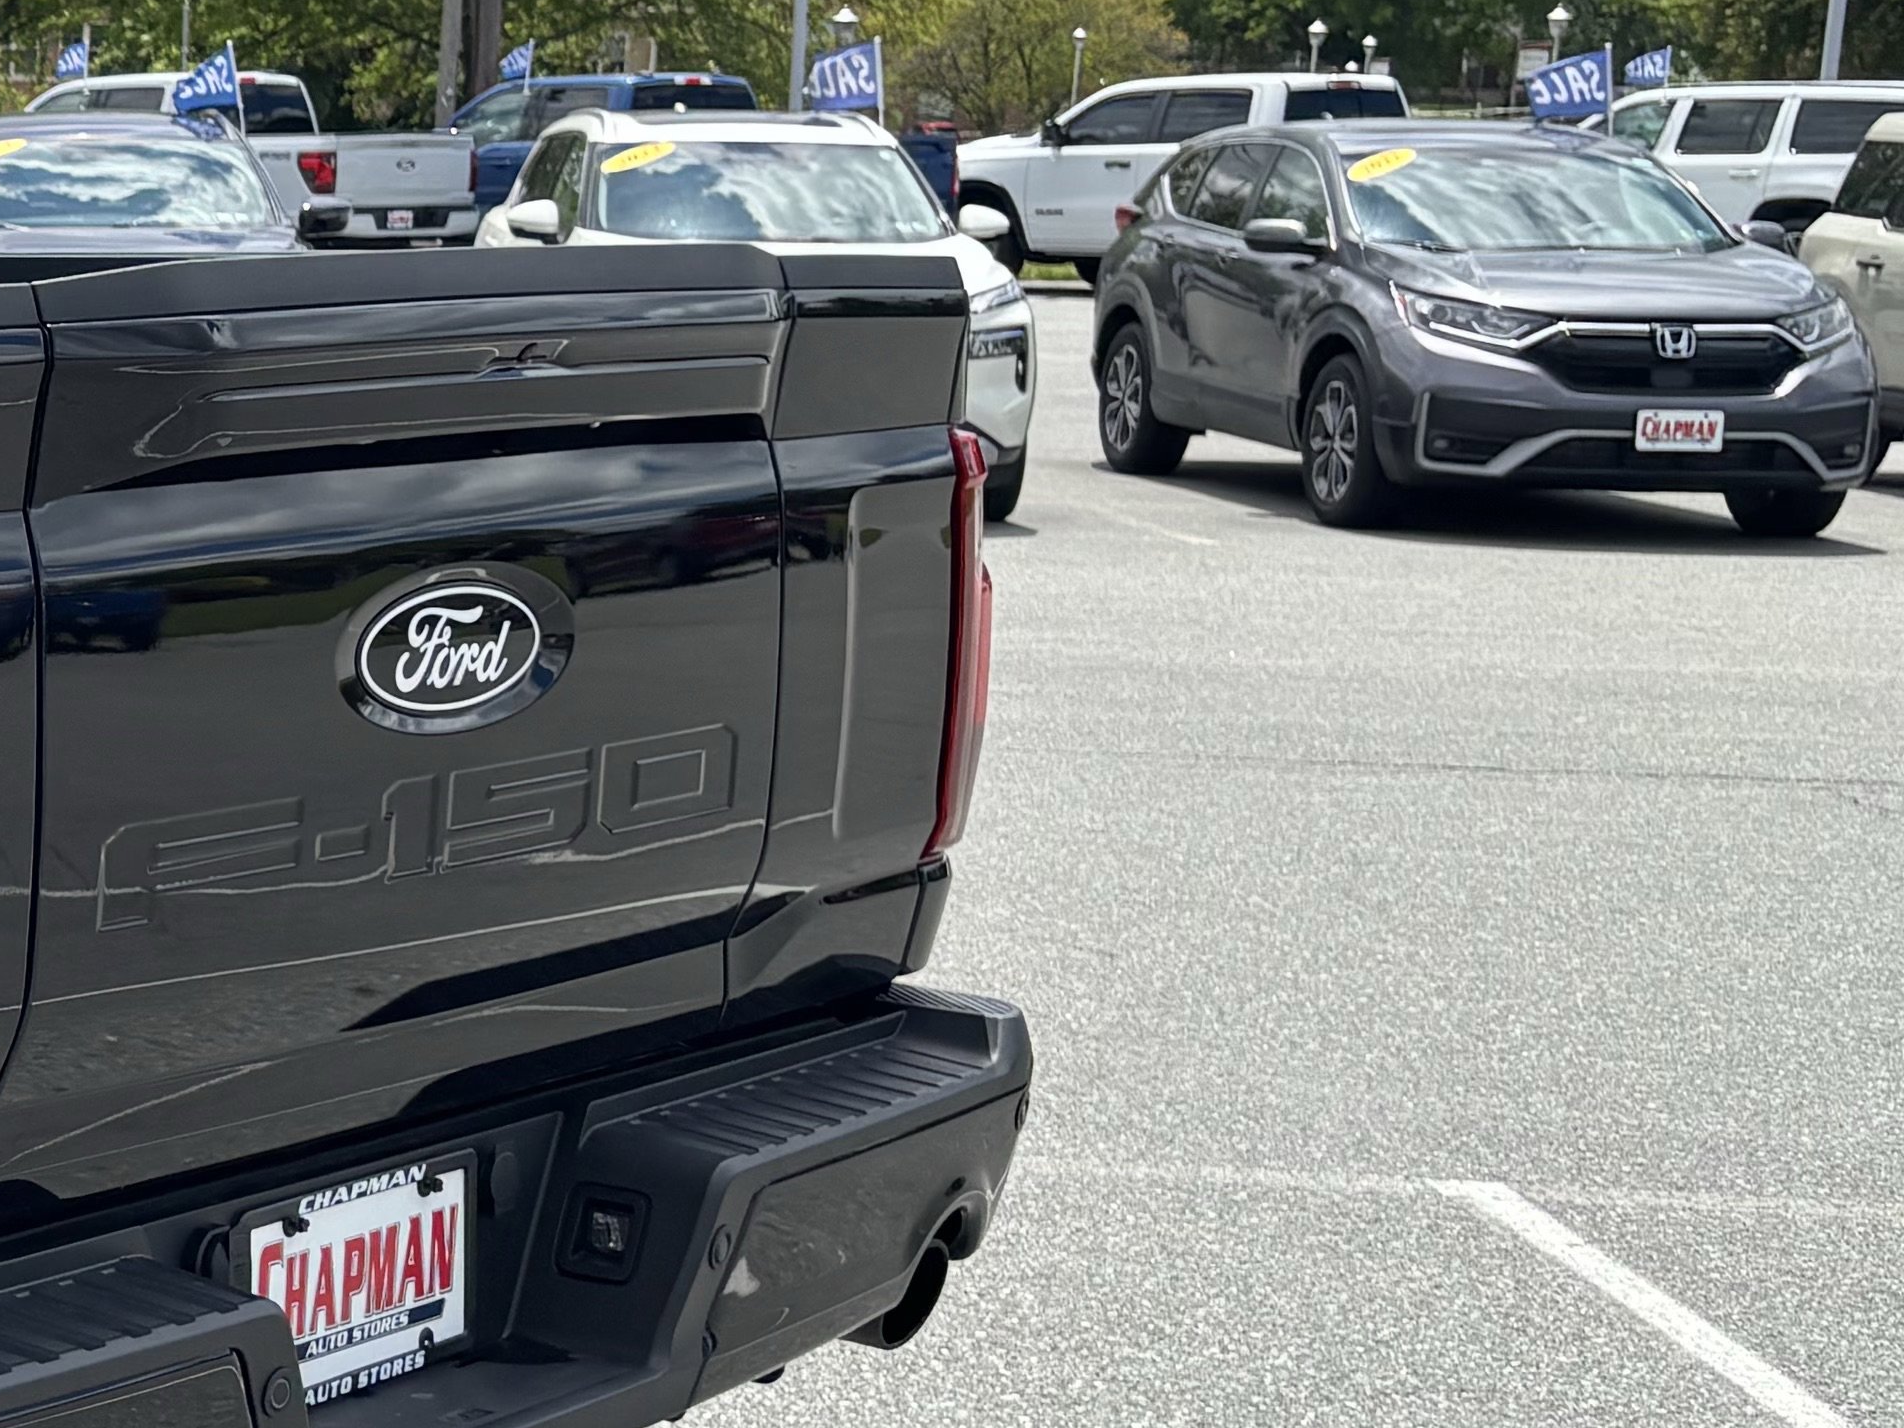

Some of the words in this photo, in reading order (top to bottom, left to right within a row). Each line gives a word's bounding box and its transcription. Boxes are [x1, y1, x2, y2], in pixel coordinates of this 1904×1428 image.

[395, 605, 510, 693] Ford
[96, 723, 737, 933] F-150
[298, 1164, 427, 1215] CHAPMAN
[305, 1332, 348, 1358] AUTO
[352, 1311, 410, 1342] STORES
[305, 1374, 352, 1406] AUTO
[358, 1350, 426, 1389] STORES
